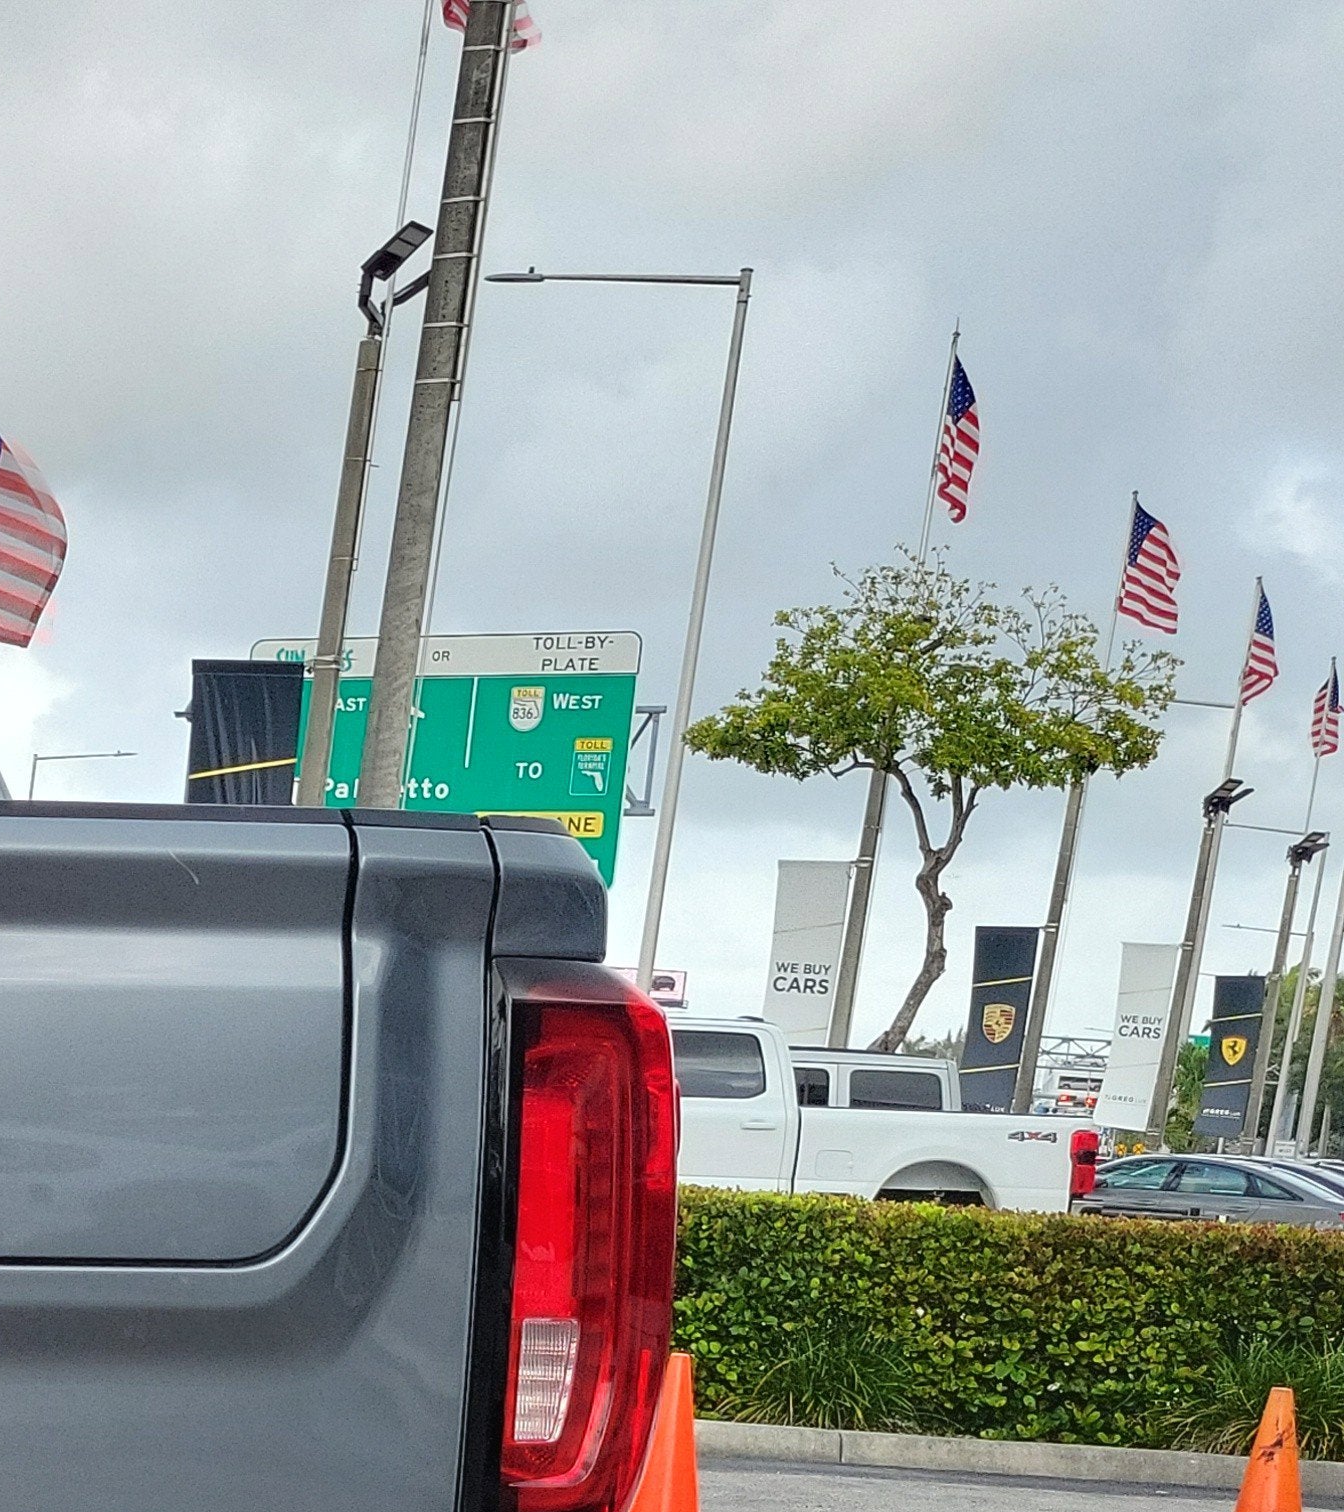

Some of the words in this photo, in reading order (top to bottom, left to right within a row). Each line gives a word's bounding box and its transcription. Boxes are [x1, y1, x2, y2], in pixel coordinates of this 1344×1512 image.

[533, 636, 614, 650] TOLL-BY-
[432, 651, 450, 662] OR
[541, 658, 600, 671] PLATE
[517, 689, 540, 697] TOLL
[334, 697, 367, 711] AST
[552, 693, 604, 710] WEST
[512, 707, 534, 720] 836
[579, 741, 607, 749] TOLL
[515, 762, 543, 779] TO
[326, 777, 450, 799] Paltto
[558, 816, 597, 833] NE
[776, 962, 799, 974] WE
[803, 964, 831, 975] BUY
[773, 976, 830, 994] CARS
[1120, 1014, 1139, 1024] WE
[1142, 1016, 1163, 1026] BUY
[1118, 1025, 1161, 1040] CARS
